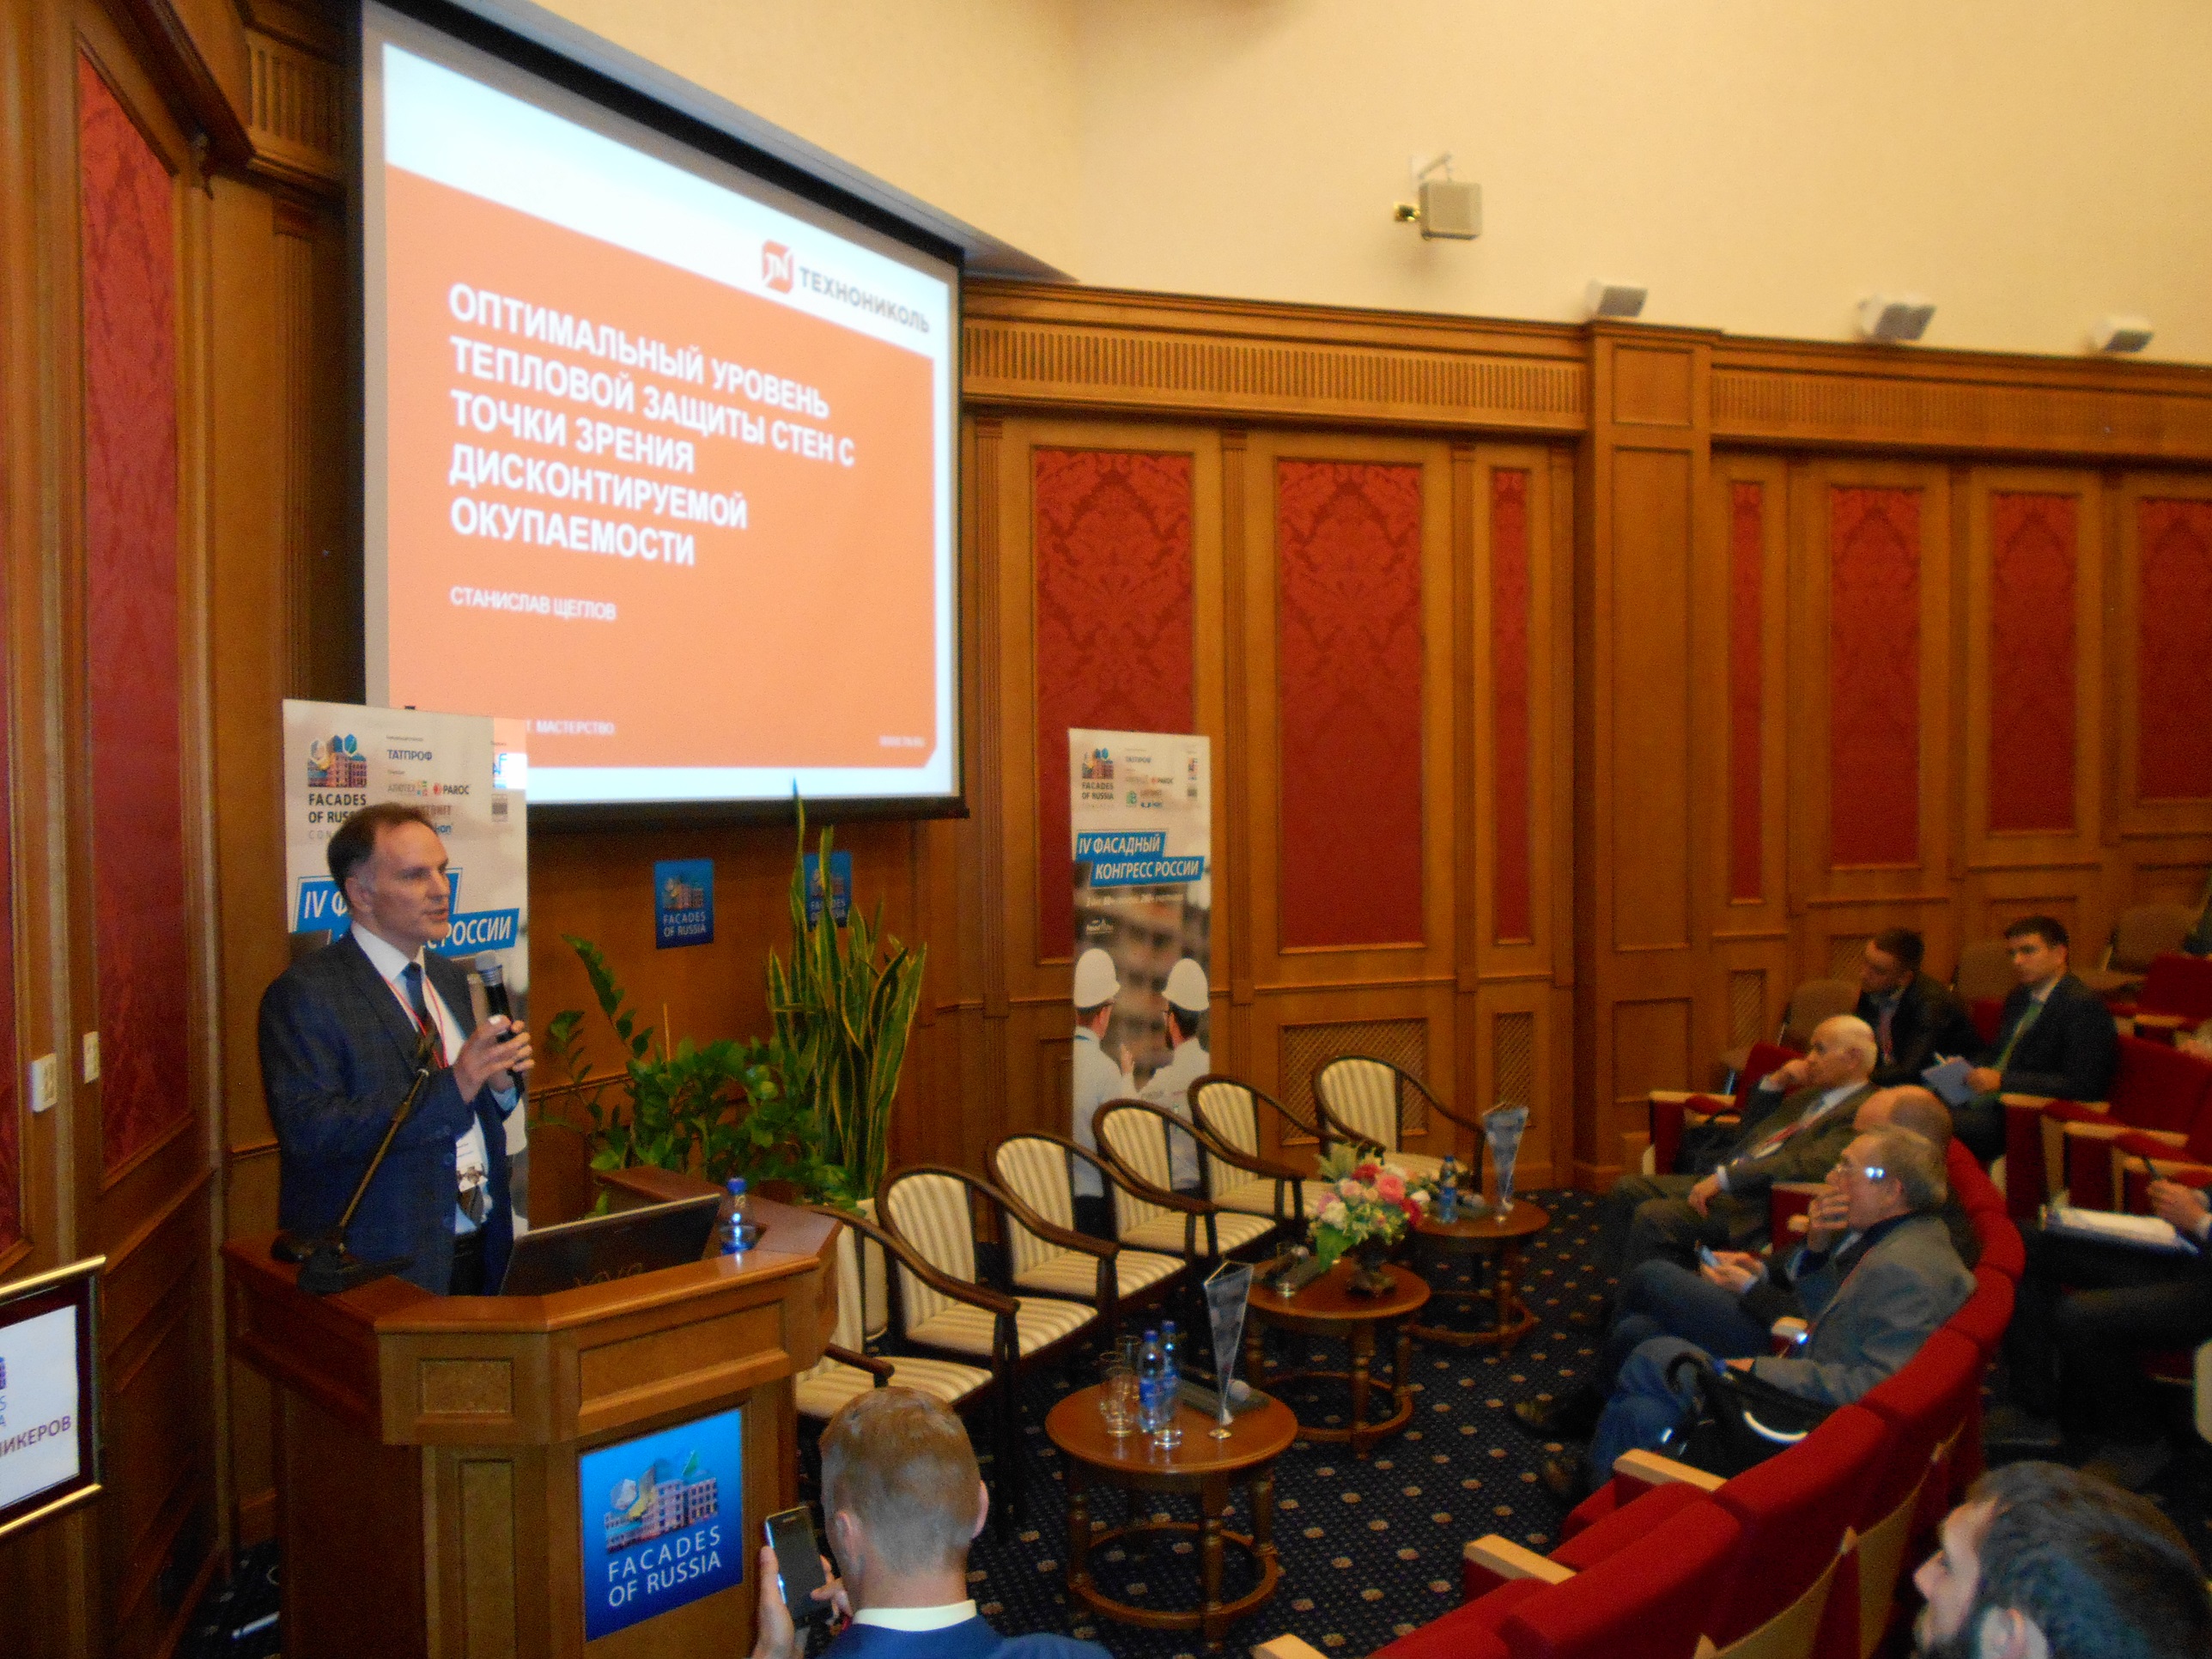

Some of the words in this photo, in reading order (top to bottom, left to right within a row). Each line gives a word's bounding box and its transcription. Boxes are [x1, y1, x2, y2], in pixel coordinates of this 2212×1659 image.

[799, 266, 930, 333] ТЕХНОНИКОЛЬ
[448, 283, 703, 384] ОПТИМАЛЬНЫЙ
[712, 357, 830, 419] УРОВЕНЬ
[450, 336, 635, 413] ТЕПЛОВОЙ
[643, 386, 765, 444] ЗАЩИТЫ
[771, 421, 834, 462] СТЕН
[839, 438, 854, 467] С
[451, 390, 567, 446] ТОЧКИ
[575, 417, 694, 473] ЗРЕНИЯ
[449, 444, 747, 529] ДИСКОНТИРУЕМОЙ
[451, 497, 695, 565] ОКУПАЕМОСТИ
[450, 586, 550, 614] СТАНИСЛАВ
[554, 599, 617, 620] ЩЕГЛОВ
[308, 793, 367, 805] FACADES
[443, 785, 470, 795] PAROC
[308, 811, 324, 823] OF
[327, 811, 353, 823] RUS
[1079, 837, 1092, 854] IV
[1093, 834, 1161, 856] ФАСАДНЫЙ
[1095, 862, 1155, 879] КОНГРЕСС
[1155, 860, 1200, 877] РОССИИ
[304, 890, 327, 919] IV
[663, 912, 706, 925] FACADES
[664, 926, 674, 938] OF
[678, 924, 706, 936] RUSSIA
[608, 1526, 721, 1583] FACADES
[608, 1579, 637, 1607] OF
[647, 1551, 722, 1594] RUSSIA
